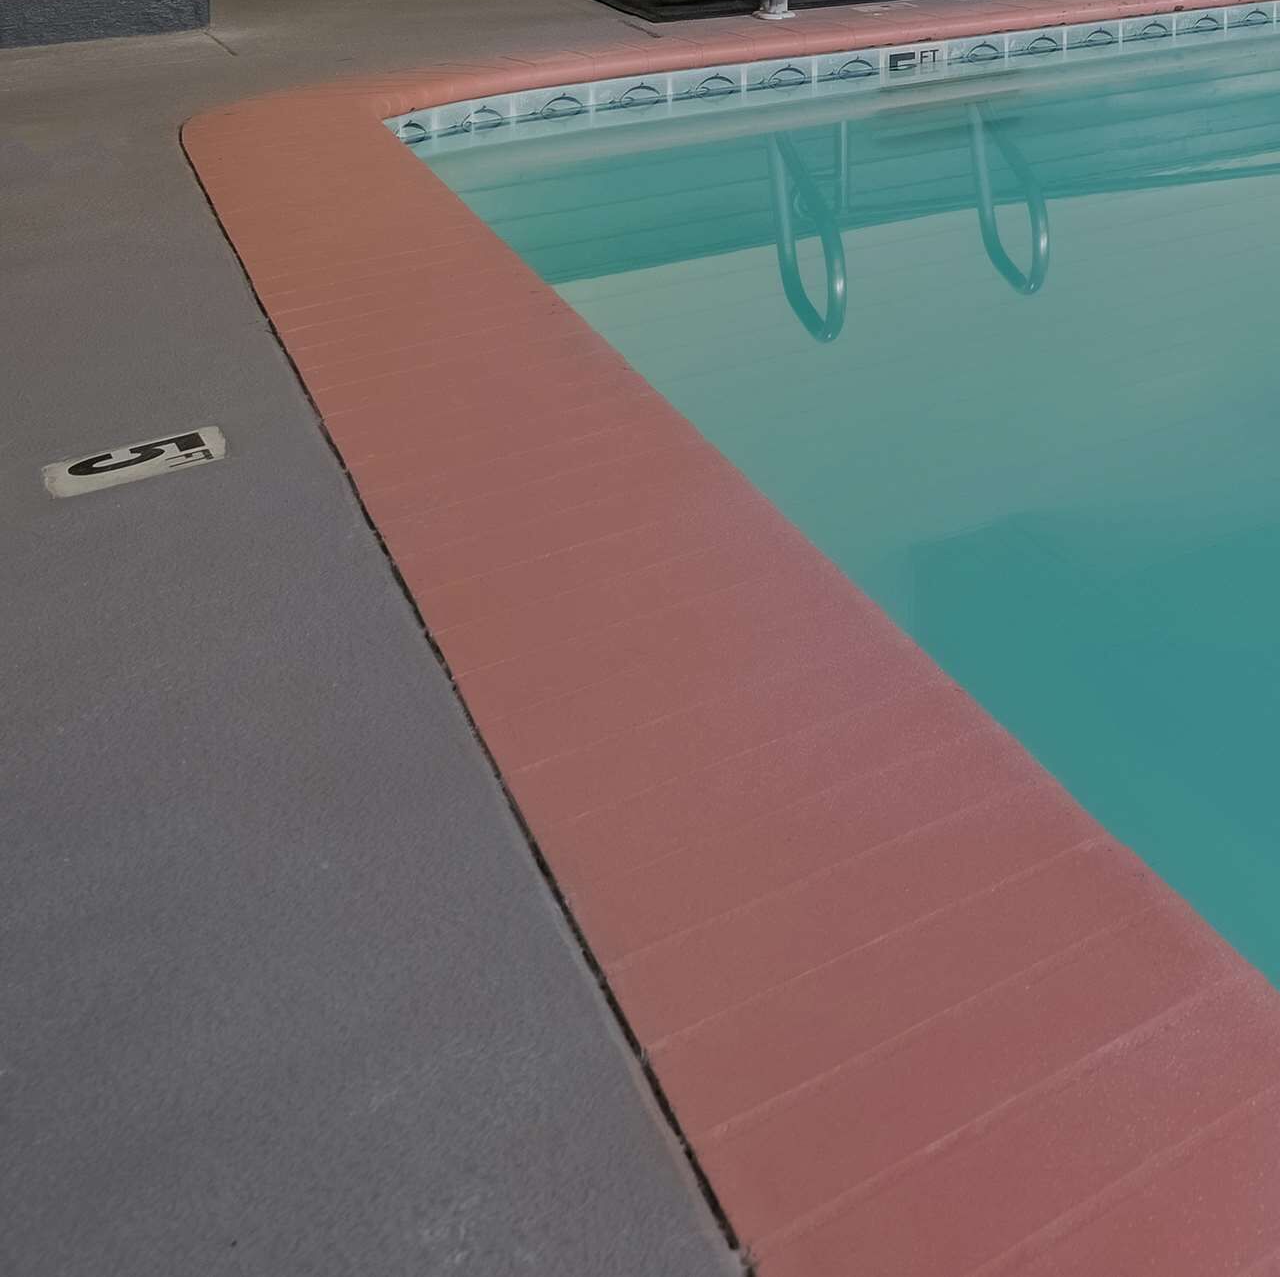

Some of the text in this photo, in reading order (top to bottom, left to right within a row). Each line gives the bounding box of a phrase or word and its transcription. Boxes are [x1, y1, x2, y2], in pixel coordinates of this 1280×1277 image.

[920, 49, 940, 64] FT
[67, 432, 214, 476] 5 FT
